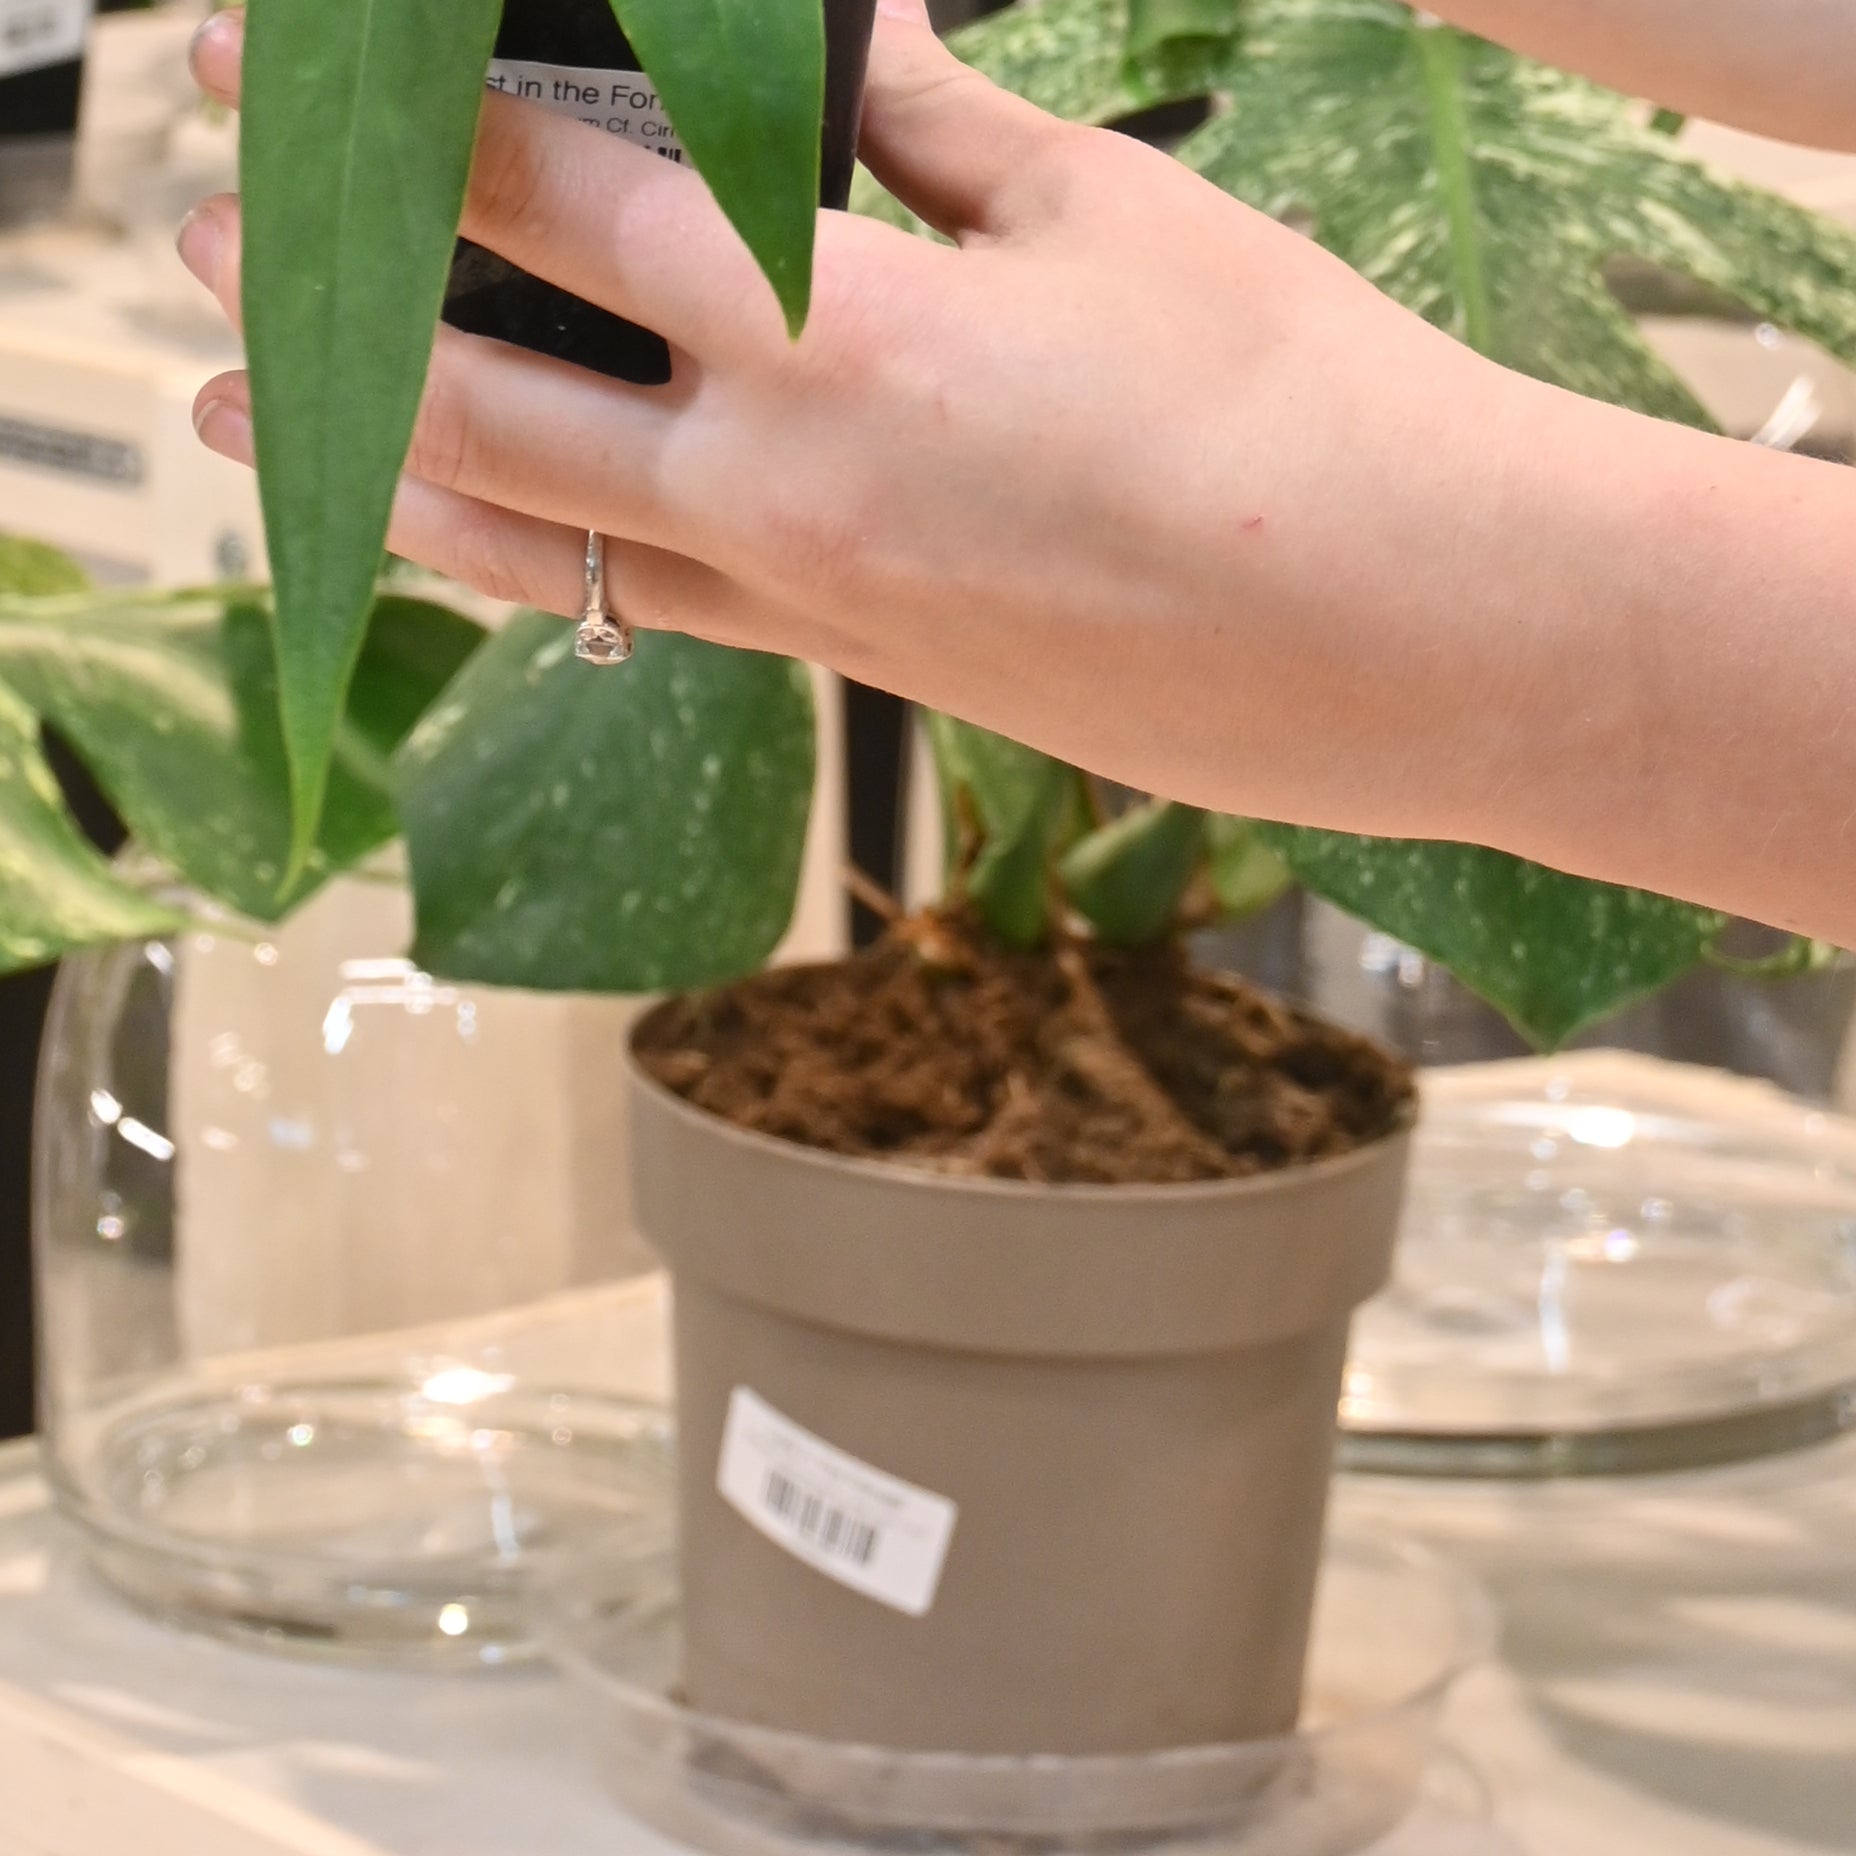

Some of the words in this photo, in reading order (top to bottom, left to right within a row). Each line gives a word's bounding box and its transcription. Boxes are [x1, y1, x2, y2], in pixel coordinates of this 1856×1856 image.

[517, 74, 542, 99] in
[553, 79, 600, 105] the
[611, 84, 664, 111] For
